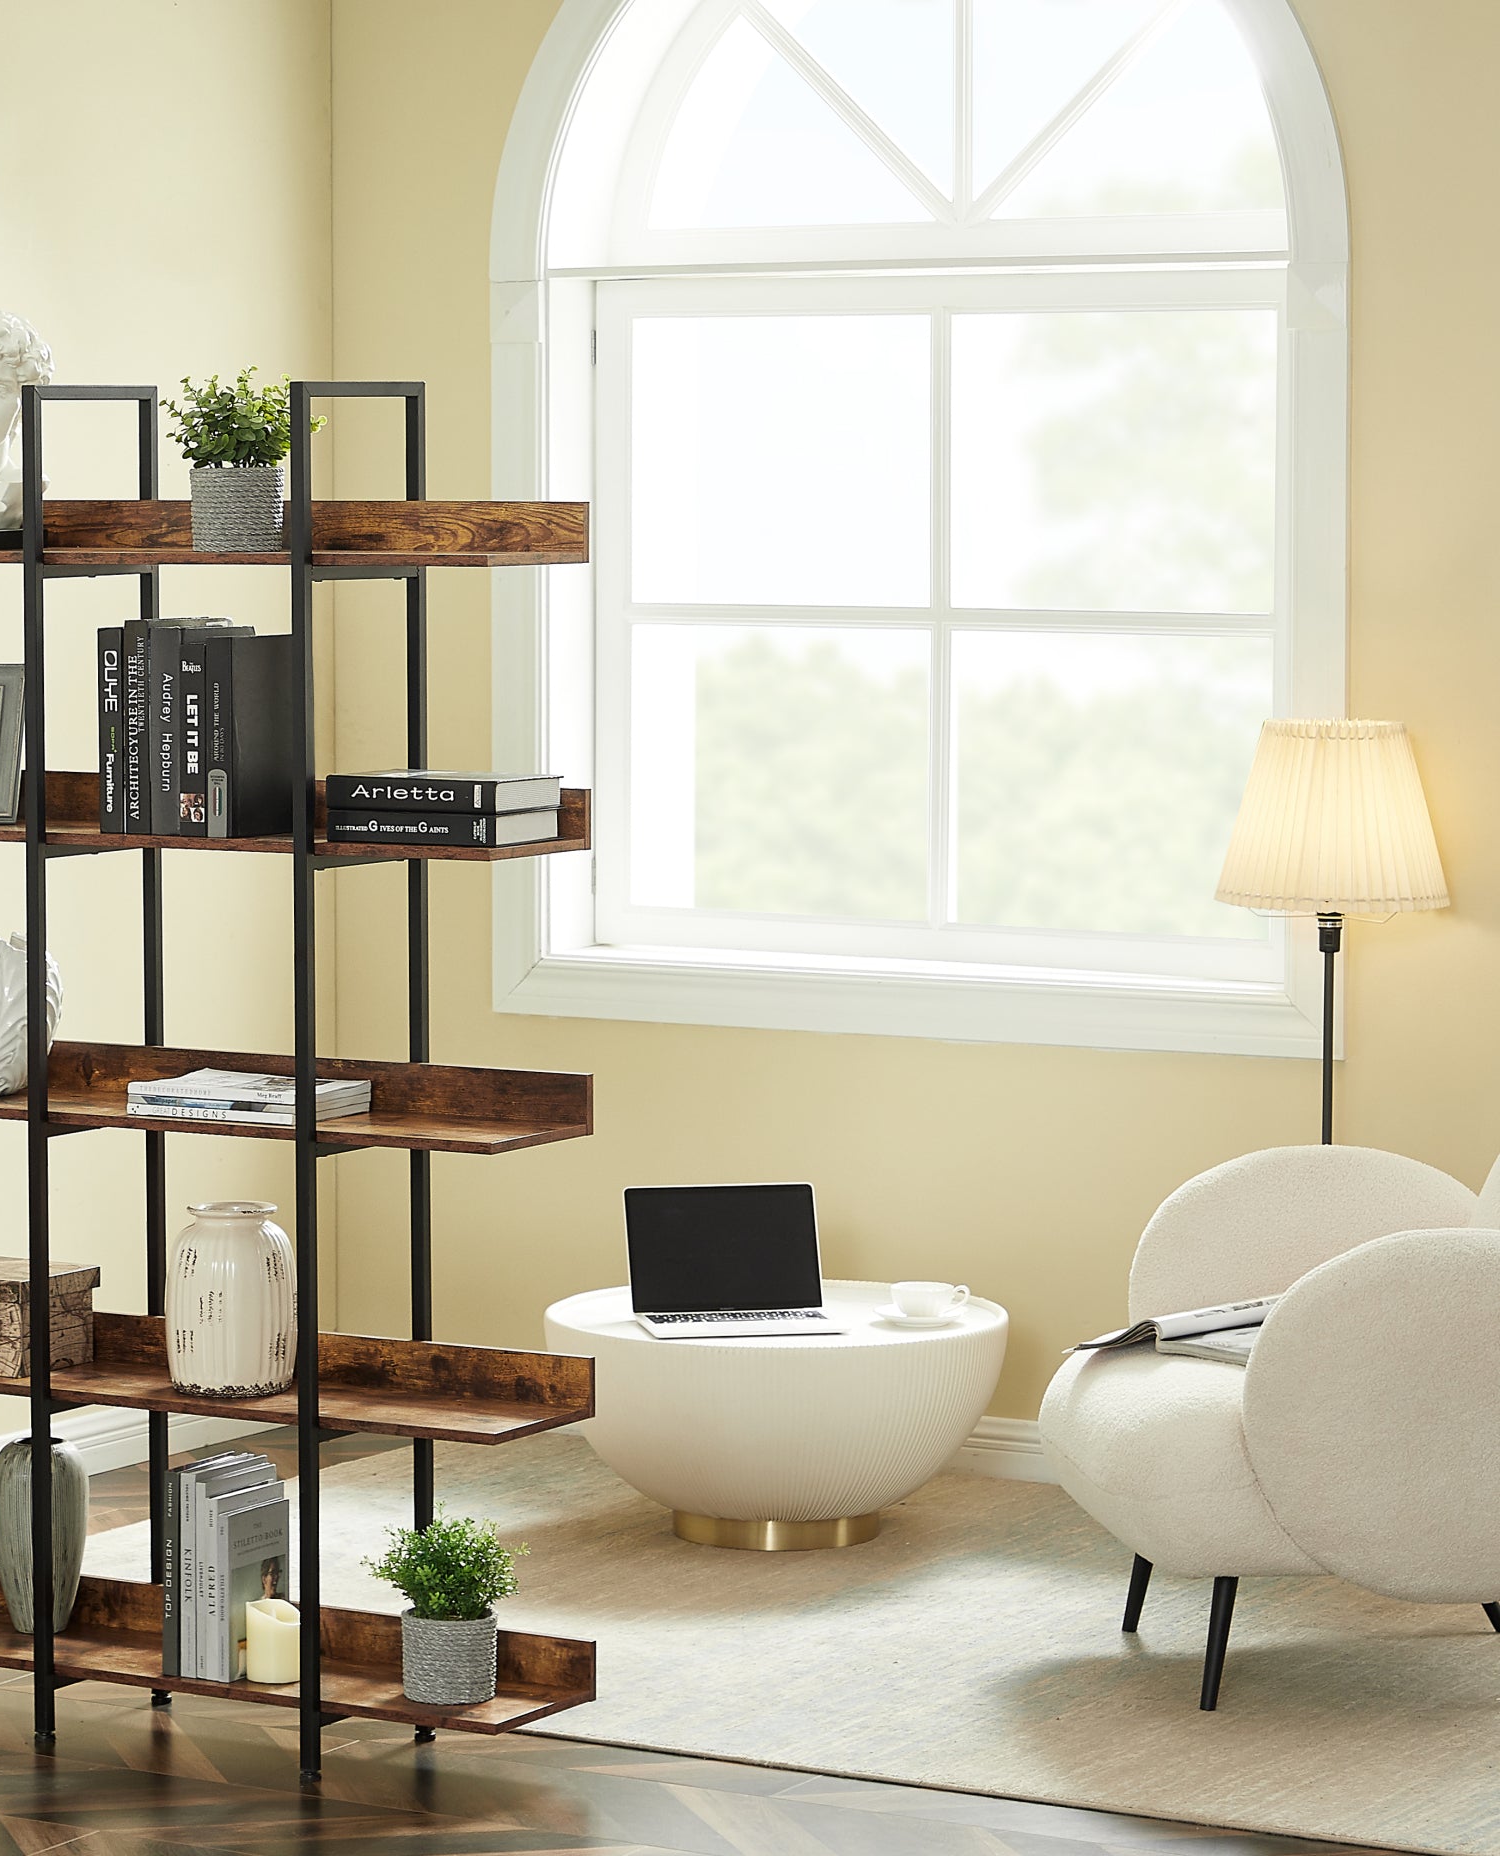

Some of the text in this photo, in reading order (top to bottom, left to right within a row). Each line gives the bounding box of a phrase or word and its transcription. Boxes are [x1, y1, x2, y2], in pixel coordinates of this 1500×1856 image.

[127, 655, 138, 685] THE
[137, 636, 145, 677] CENTURY
[128, 689, 138, 704] IN
[160, 673, 173, 792] Audrey Hepburn
[187, 694, 198, 774] LET IT BE
[351, 784, 454, 802] Arletta
[171, 1108, 227, 1118] DESIGNS
[232, 1534, 263, 1549] STILETTO
[265, 1528, 283, 1540] BOOK
[184, 1548, 192, 1602] KINFOLK
